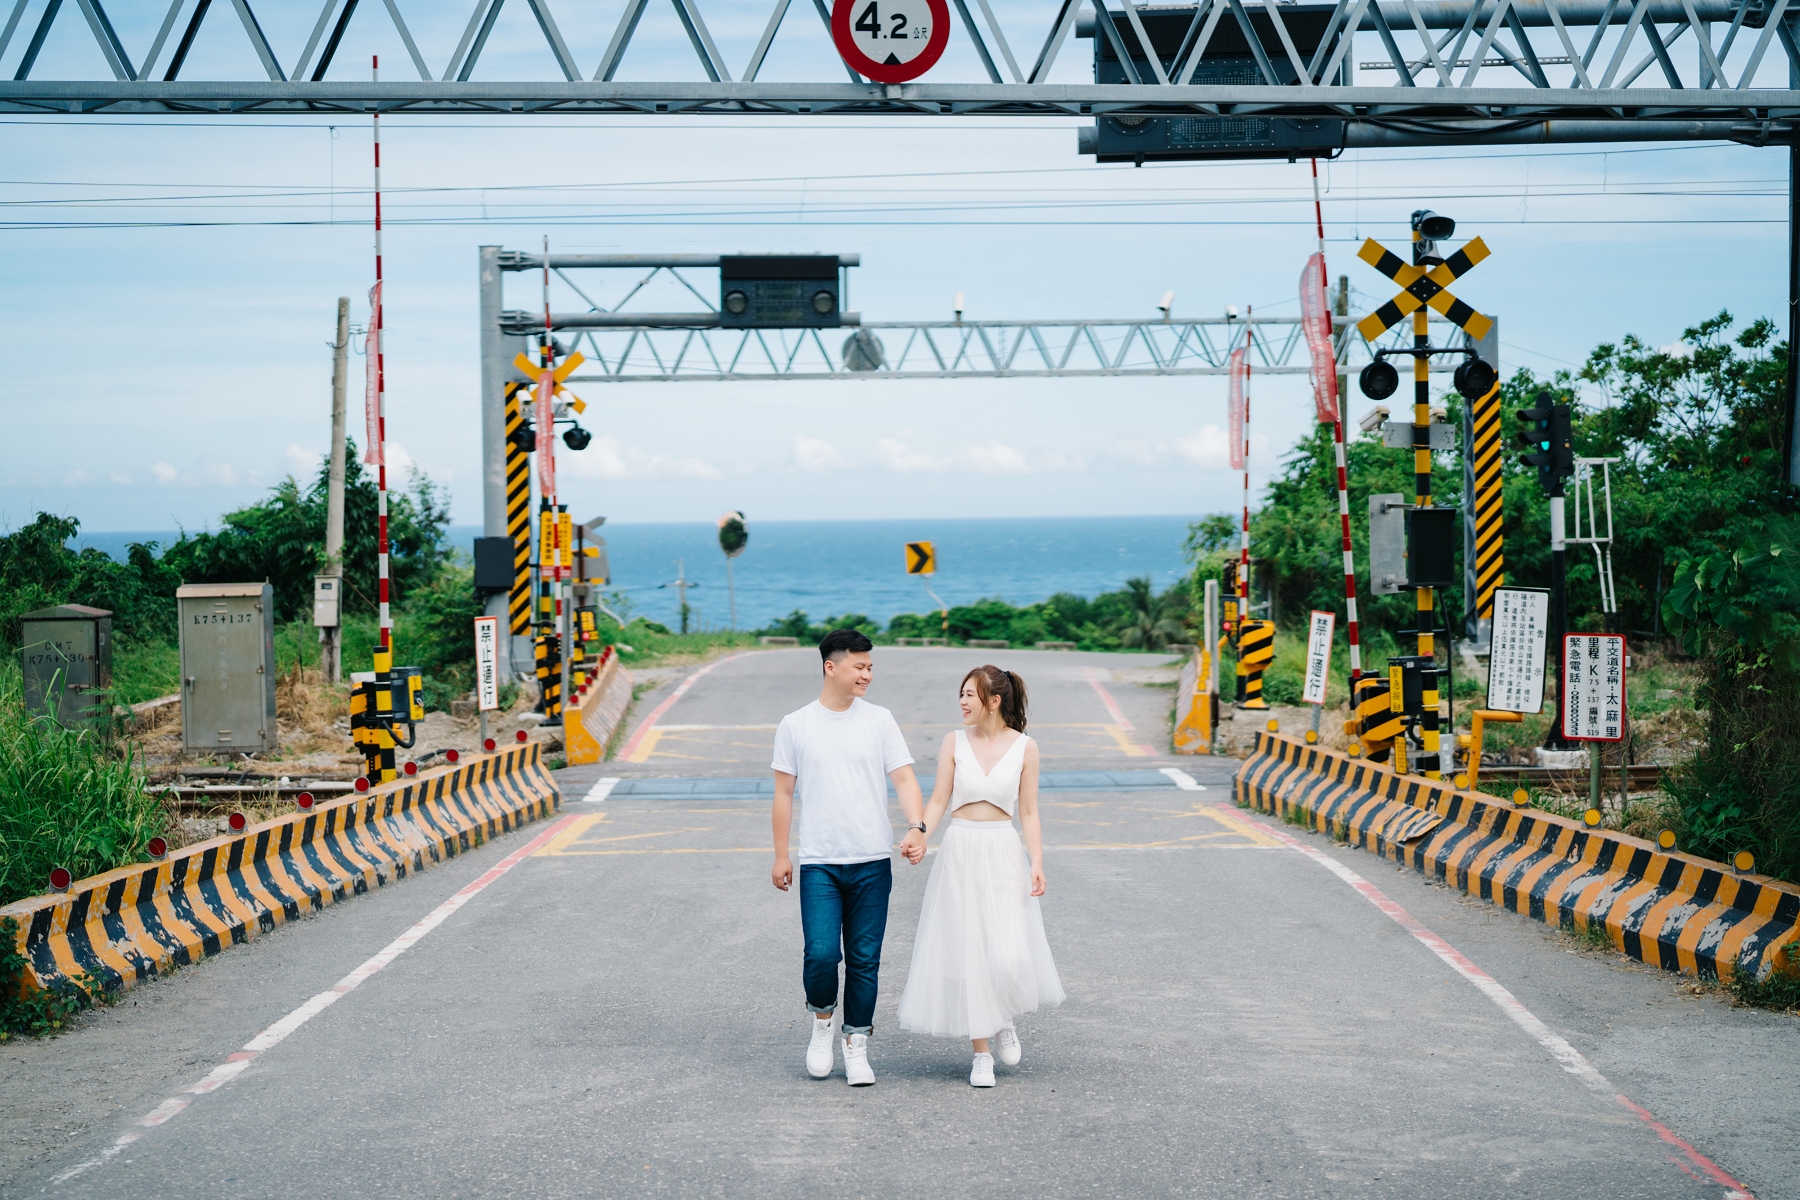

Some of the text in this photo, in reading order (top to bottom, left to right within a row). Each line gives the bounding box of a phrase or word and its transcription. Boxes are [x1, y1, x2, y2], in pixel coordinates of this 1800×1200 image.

[855, 1, 928, 39] 4.2 公尺
[194, 614, 252, 625] K75+137
[480, 624, 493, 706] 禁止通行
[1309, 617, 1328, 697] 禁止通行
